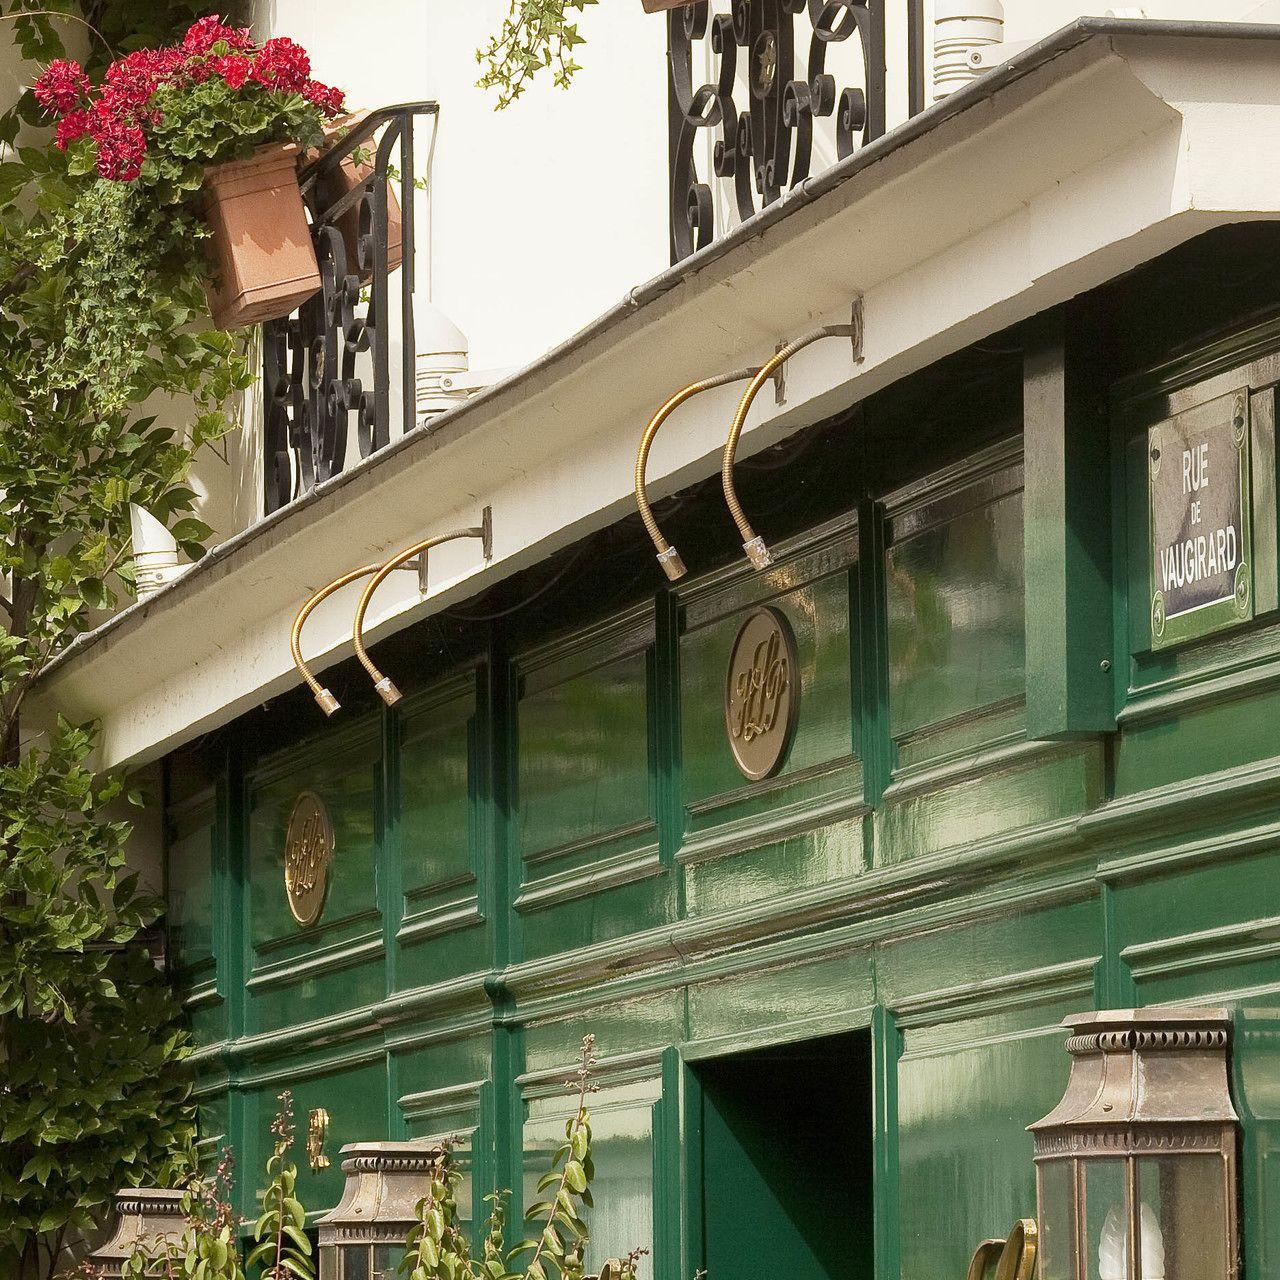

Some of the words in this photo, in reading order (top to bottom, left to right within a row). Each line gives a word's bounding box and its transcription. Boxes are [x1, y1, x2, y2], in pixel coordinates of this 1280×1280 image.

[1182, 442, 1209, 495] RUE
[1191, 500, 1201, 525] DE
[1160, 525, 1237, 592] VAUGIRARD
